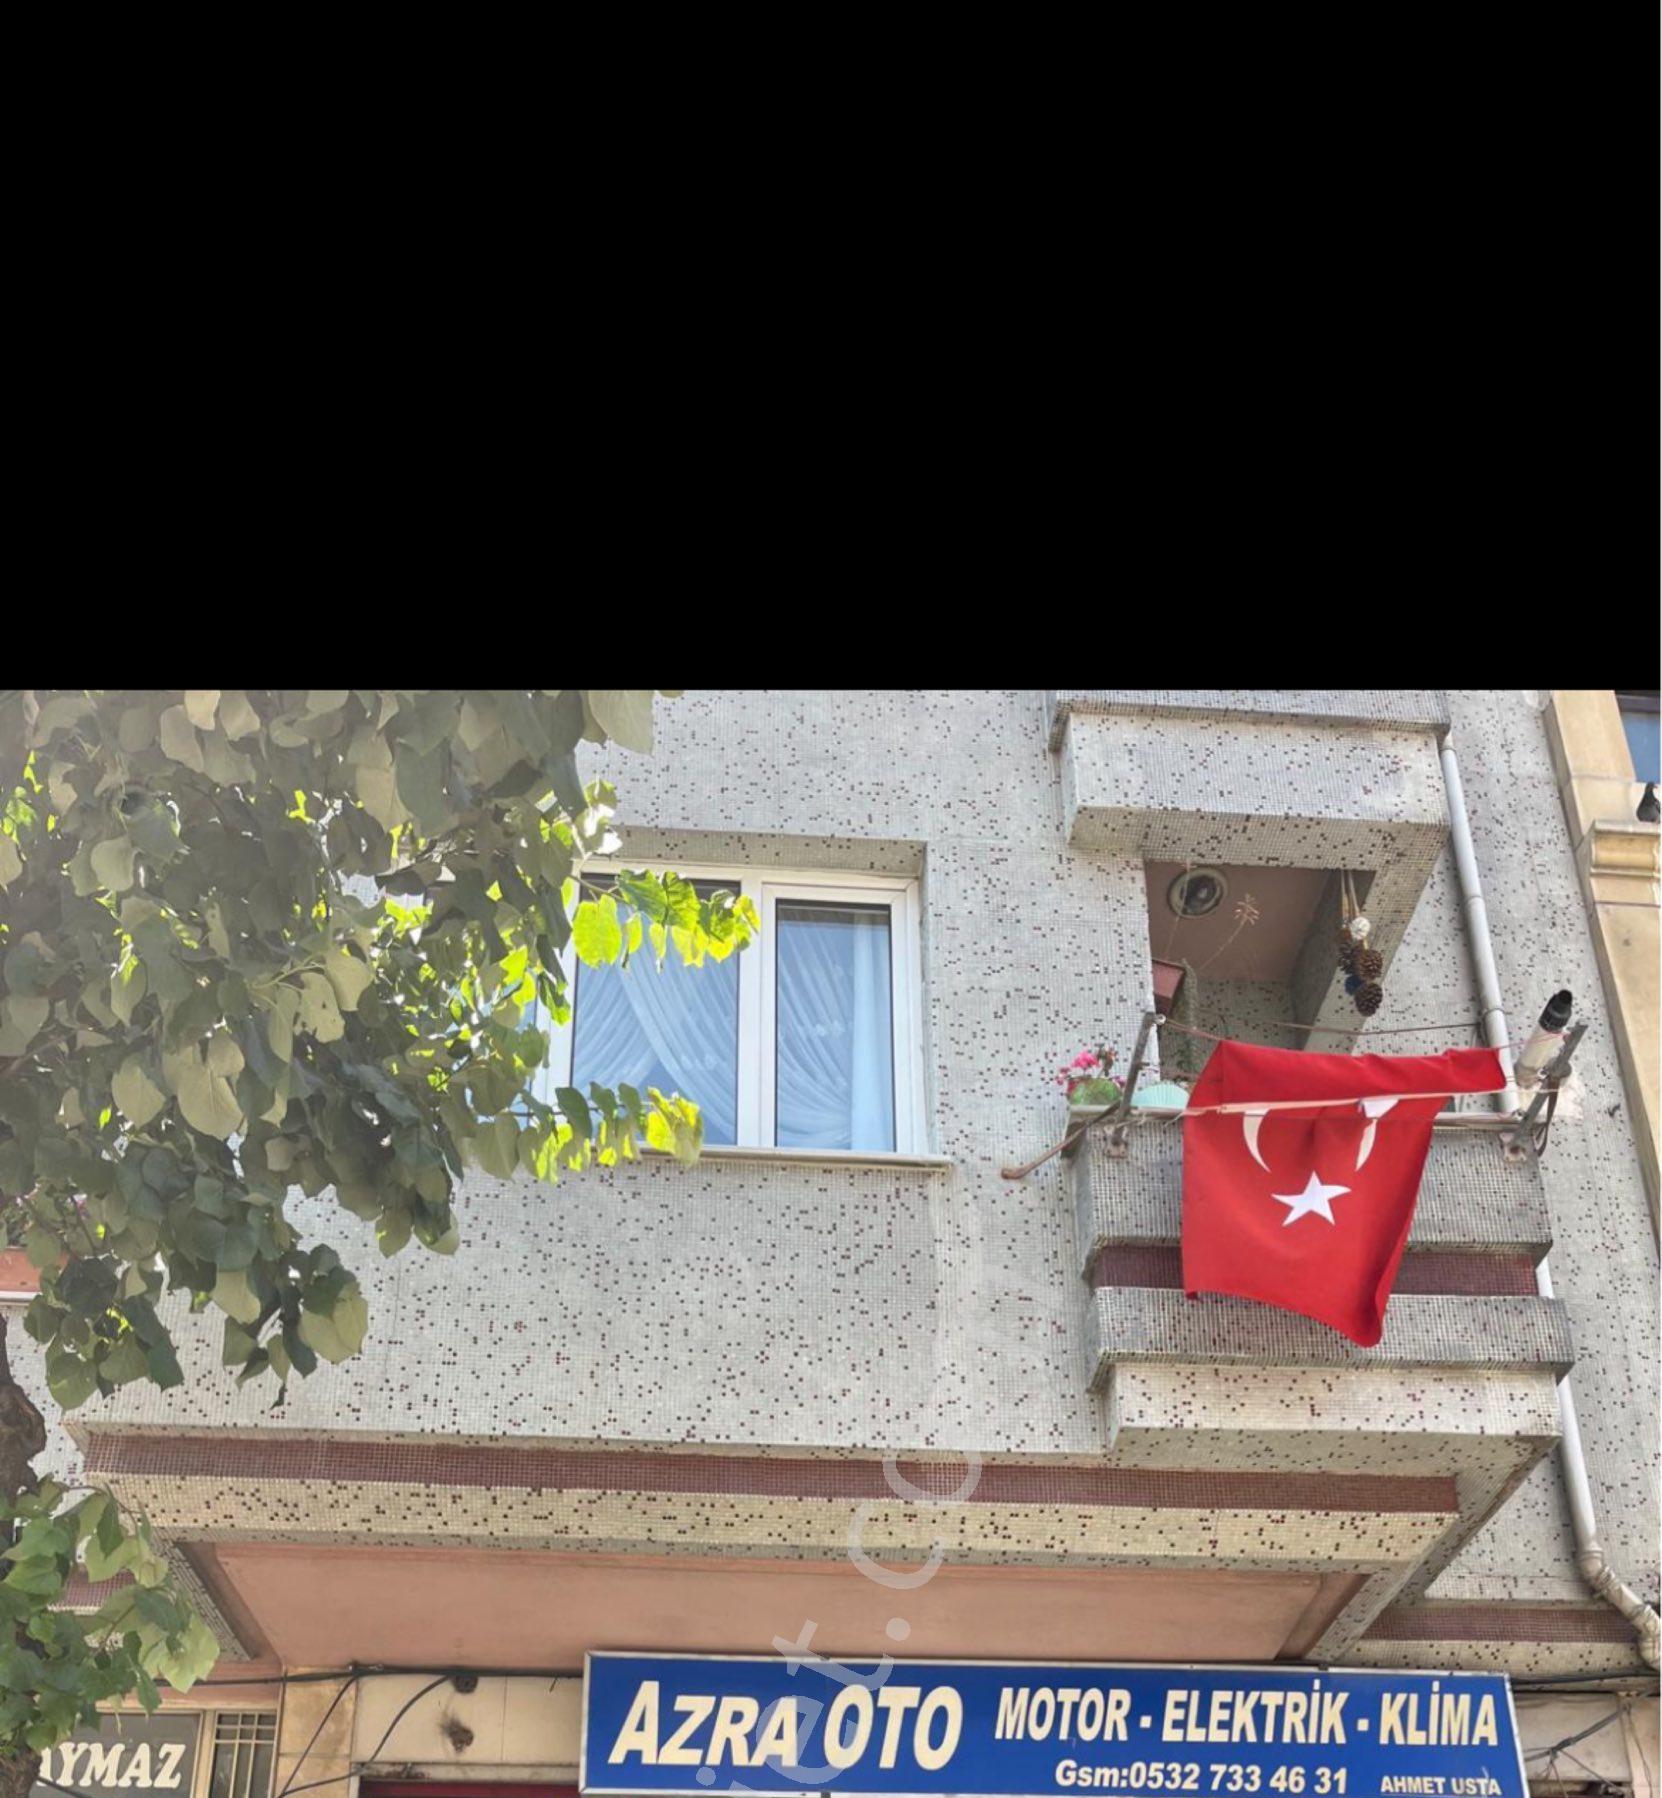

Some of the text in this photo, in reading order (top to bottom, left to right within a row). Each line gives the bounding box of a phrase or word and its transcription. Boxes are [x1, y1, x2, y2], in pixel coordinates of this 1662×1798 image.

[607, 1679, 1498, 1771] AZRA OTO MOTOR - ELEKTRİK - KLİMA
[1055, 1759, 1348, 1794] Gsm:0532 733 46 31
[1381, 1775, 1503, 1797] AHMET USTA
